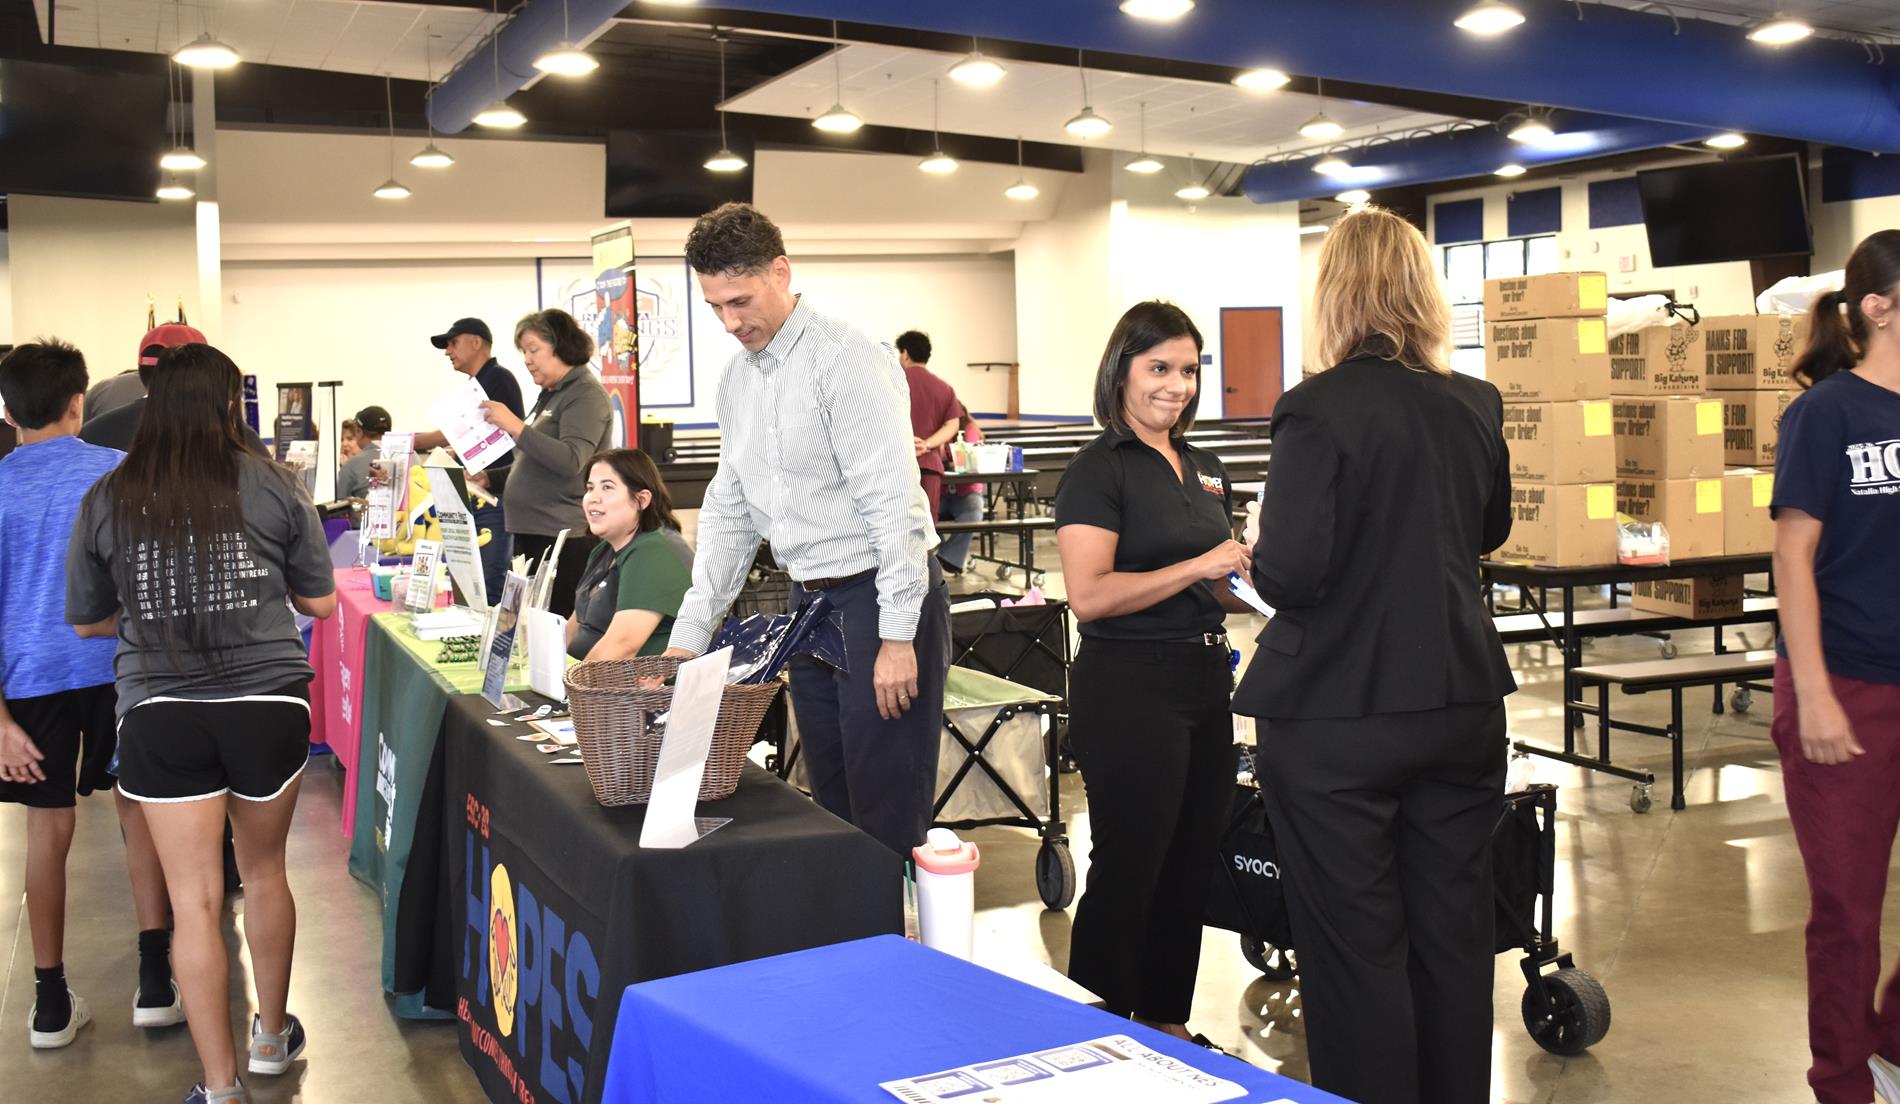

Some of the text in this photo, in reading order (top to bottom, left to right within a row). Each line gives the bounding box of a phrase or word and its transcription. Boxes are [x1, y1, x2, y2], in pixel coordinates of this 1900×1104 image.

[1493, 323, 1537, 342] Questions about
[1733, 328, 1747, 350] FOR
[1497, 341, 1532, 362] your Order?
[1626, 333, 1639, 355] FOR
[1611, 358, 1646, 380] SUPPORT!
[1716, 353, 1754, 375] SUPPORT!
[1655, 373, 1699, 384] Big Kahuna
[1763, 367, 1776, 379] Big
[1527, 407, 1542, 422] about
[1639, 402, 1655, 419] about
[1731, 404, 1746, 426] FOR
[1518, 424, 1537, 440] Order?
[1628, 420, 1650, 436] Order?
[1528, 488, 1545, 504] about
[1639, 481, 1655, 498] about
[1850, 485, 1898, 496] Natalia High
[1518, 505, 1540, 521] Order?
[1628, 499, 1650, 515] Order?
[233, 568, 269, 579] CNTRERAS
[1655, 580, 1691, 605] SUPPORT!
[1136, 1052, 1194, 1074] ABOUT
